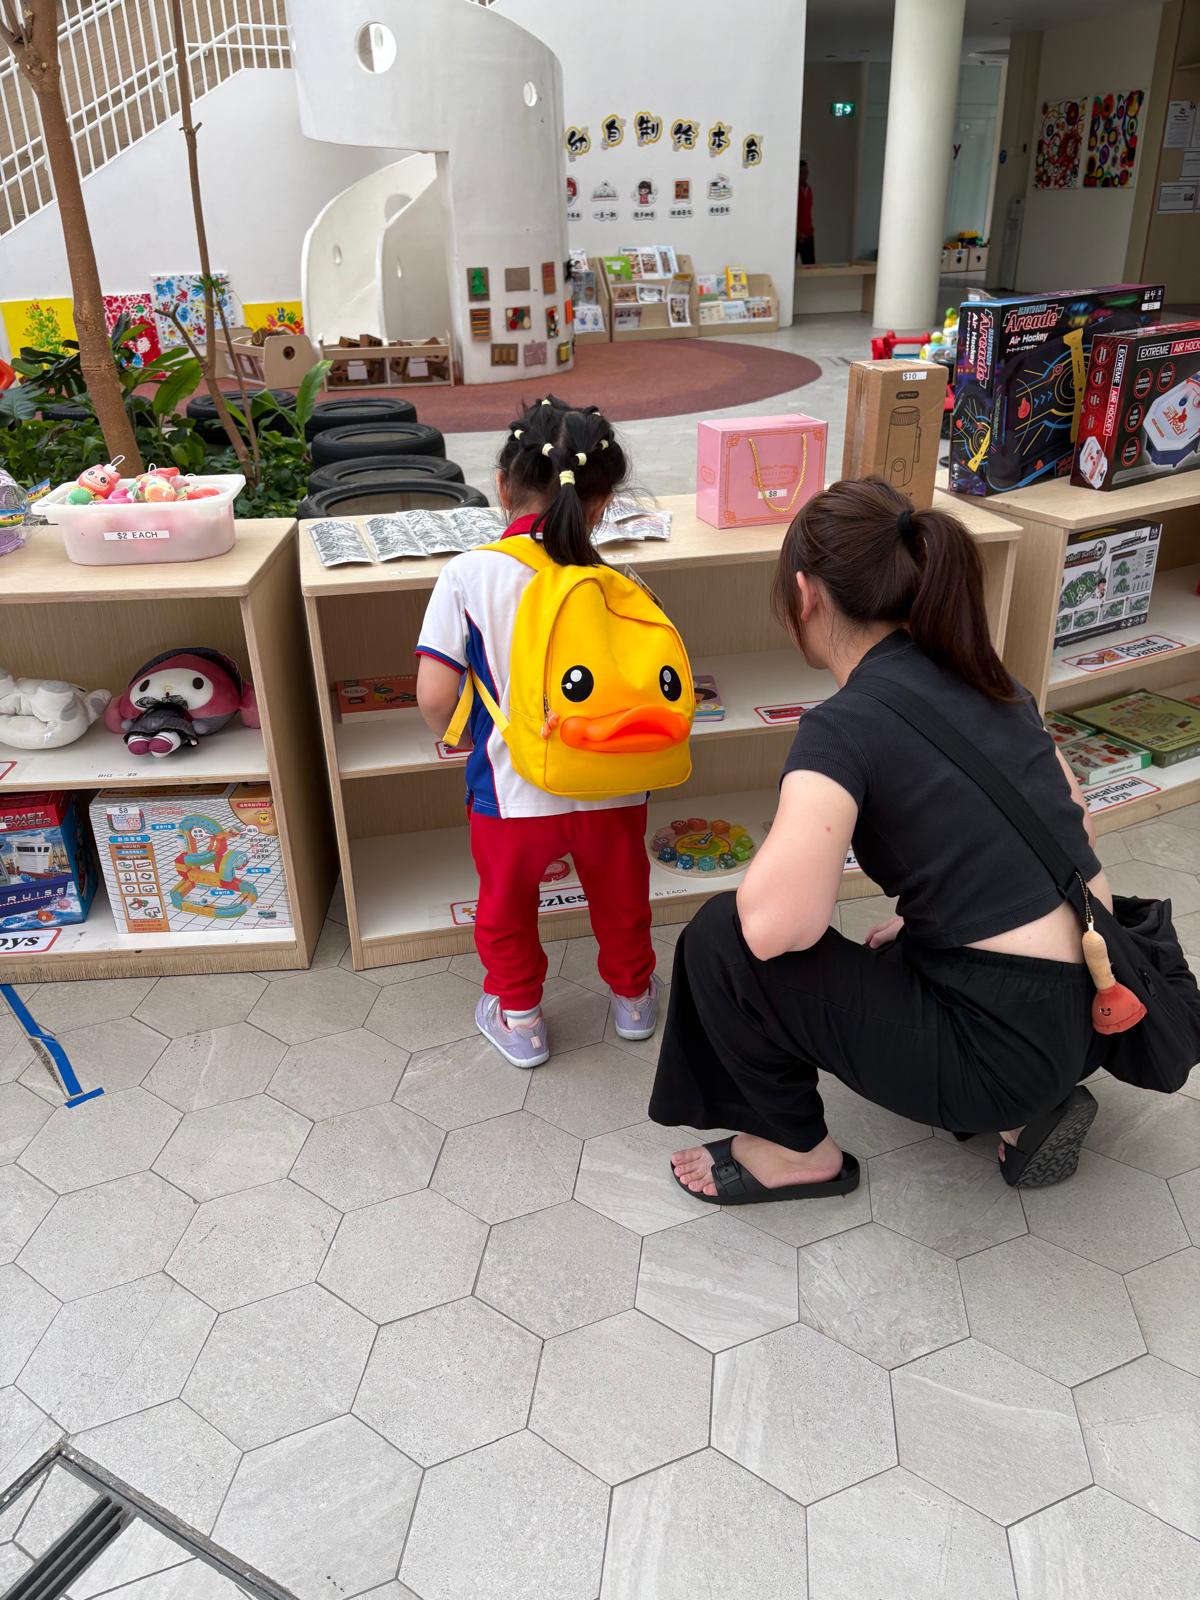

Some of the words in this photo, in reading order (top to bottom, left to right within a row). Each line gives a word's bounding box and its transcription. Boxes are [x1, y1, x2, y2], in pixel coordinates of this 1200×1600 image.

[1005, 309, 1059, 334] Arcade
[1009, 335, 1021, 346] Air
[1022, 331, 1049, 343] Hockey
[968, 330, 978, 366] Hockey
[976, 312, 991, 381] Arcade
[1140, 345, 1170, 358] EXTREME
[1173, 343, 1184, 353] AIR
[1113, 348, 1126, 384] EXTREME
[903, 373, 917, 381] $10
[1105, 404, 1115, 434] HOCKEY
[769, 490, 777, 498] $8
[117, 532, 128, 540] $2
[132, 531, 158, 539] EACH
[1115, 639, 1158, 654] Board
[1126, 644, 1173, 658] Games
[1083, 779, 1142, 801] ucational
[1099, 792, 1132, 804] Toys
[6, 818, 51, 828] OYAGER
[8, 887, 64, 903] RUISE
[538, 894, 587, 908] zzles
